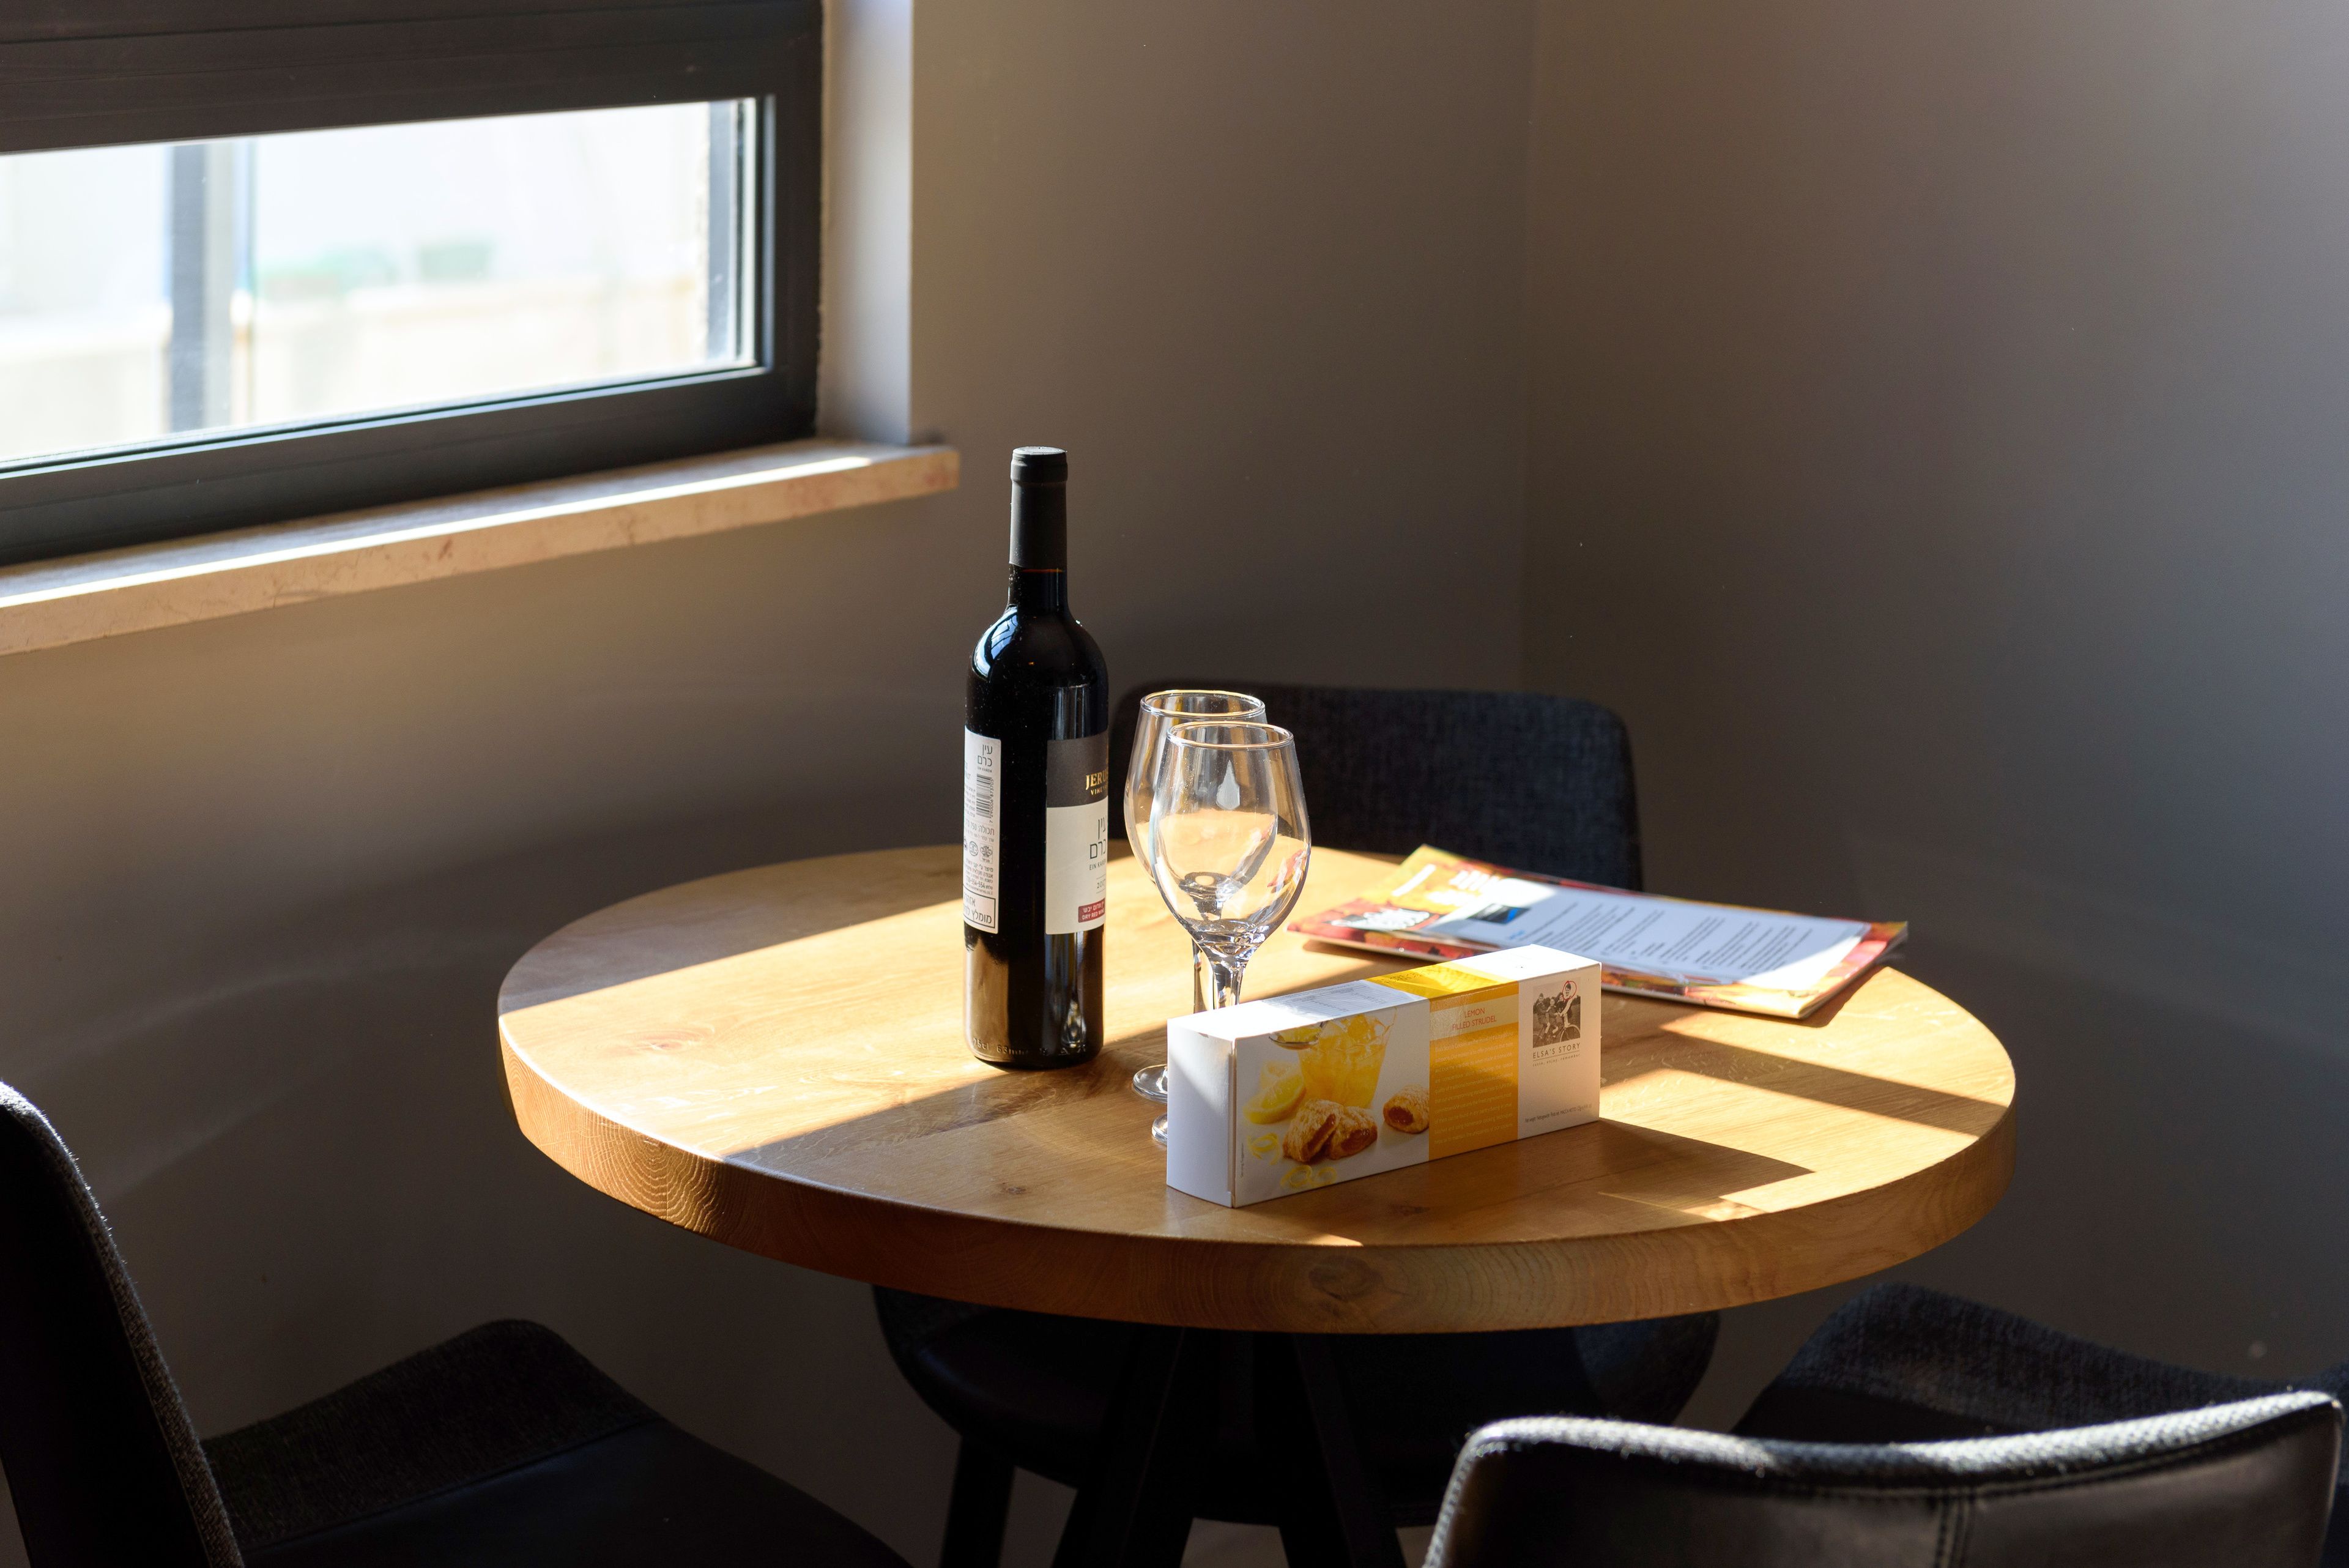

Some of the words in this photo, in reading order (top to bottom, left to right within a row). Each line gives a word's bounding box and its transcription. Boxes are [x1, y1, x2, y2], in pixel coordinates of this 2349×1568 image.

[982, 745, 993, 756] עין
[978, 755, 992, 767] כרם
[971, 909, 992, 924] מומלץ
[1464, 1008, 1485, 1018] LEMON
[1452, 1020, 1471, 1031] FILLED
[1472, 1016, 1497, 1027] STRUDEL
[1533, 1048, 1555, 1058] ELSA'S
[1559, 1042, 1580, 1053] STORY
